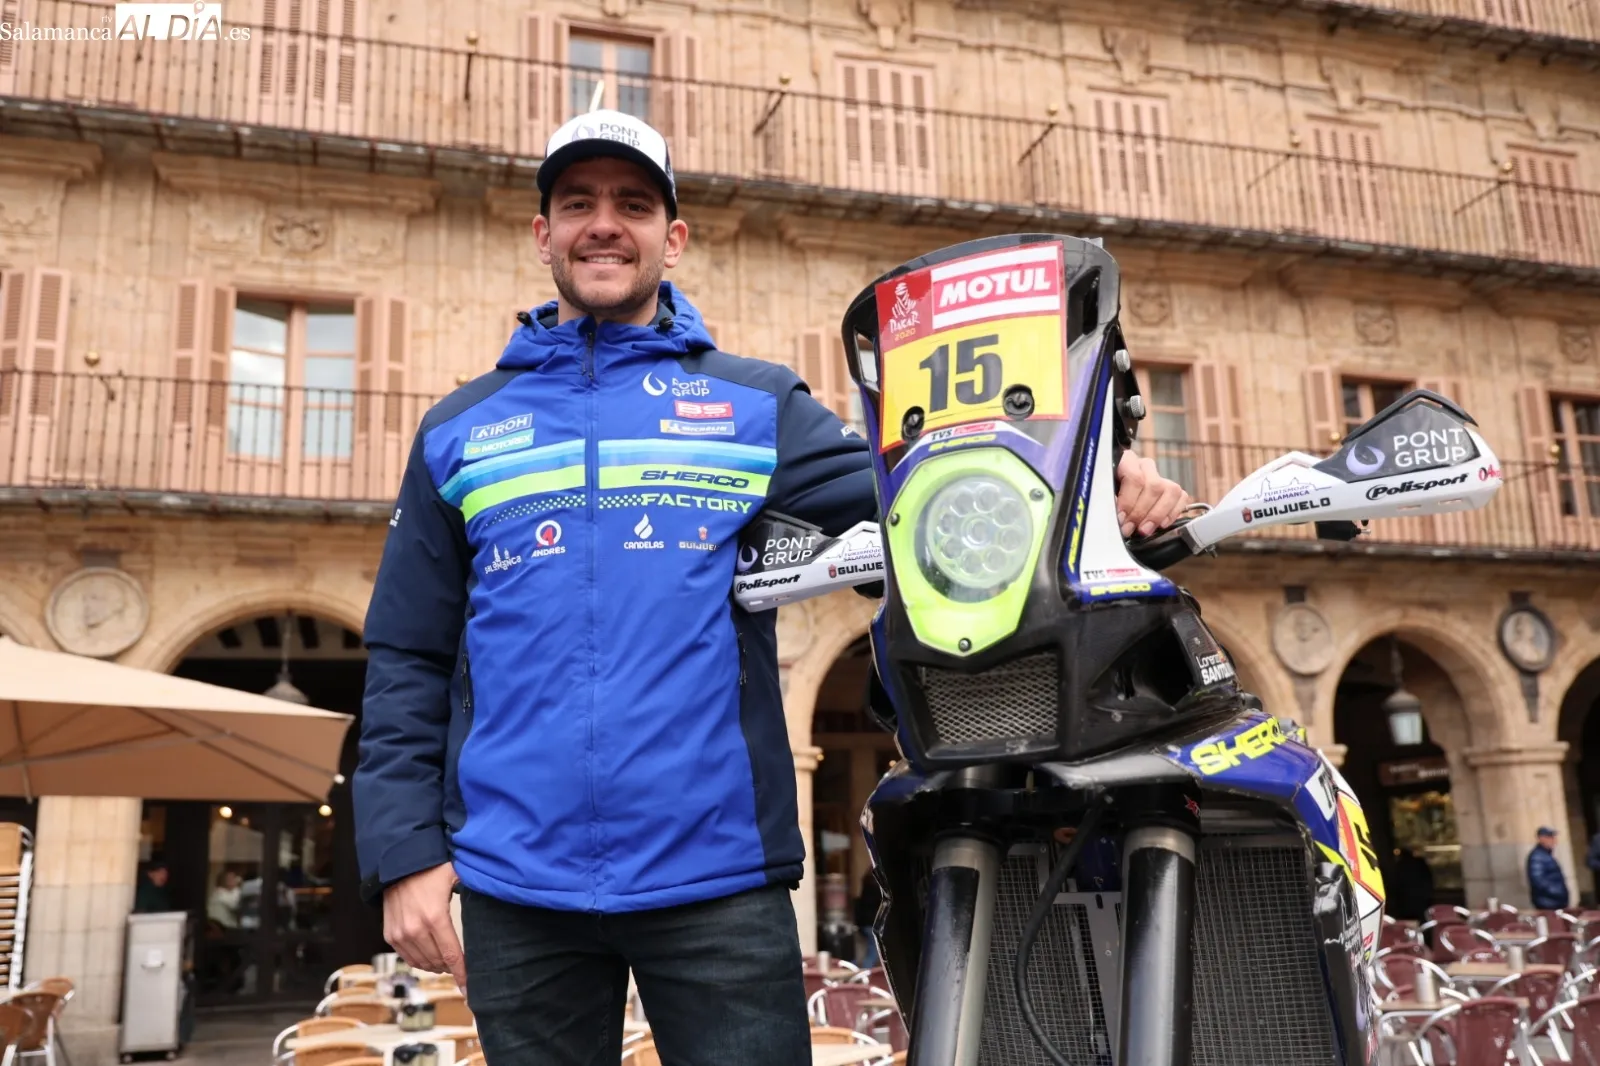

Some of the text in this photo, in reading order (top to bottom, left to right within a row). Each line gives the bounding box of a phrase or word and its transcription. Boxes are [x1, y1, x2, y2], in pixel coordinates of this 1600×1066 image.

[599, 122, 640, 139] PONT
[939, 267, 1051, 308] MOTUL
[889, 311, 920, 333] DAKAR
[895, 328, 916, 341] 2020
[919, 333, 1004, 414] 15
[671, 388, 710, 397] GRUP
[672, 377, 709, 390] PONT
[677, 402, 727, 415] BS
[475, 416, 528, 439] AIROH
[930, 429, 953, 441] TVS
[481, 434, 531, 453] MOTOREX
[1393, 428, 1464, 451] PONT
[1395, 446, 1467, 468] GRUP
[640, 470, 750, 489] SHERCO
[1366, 472, 1469, 501] Polisport
[640, 492, 753, 514] FACTORY
[1263, 489, 1310, 503] SALAMANCA
[1253, 497, 1331, 519] GUIJUELO
[623, 540, 665, 550] CANDELAS
[679, 541, 717, 551] GUIJUE
[764, 535, 817, 551] PONT
[762, 549, 813, 566] GRUP
[837, 561, 884, 575] GUIJUE
[736, 573, 801, 594] Polisport
